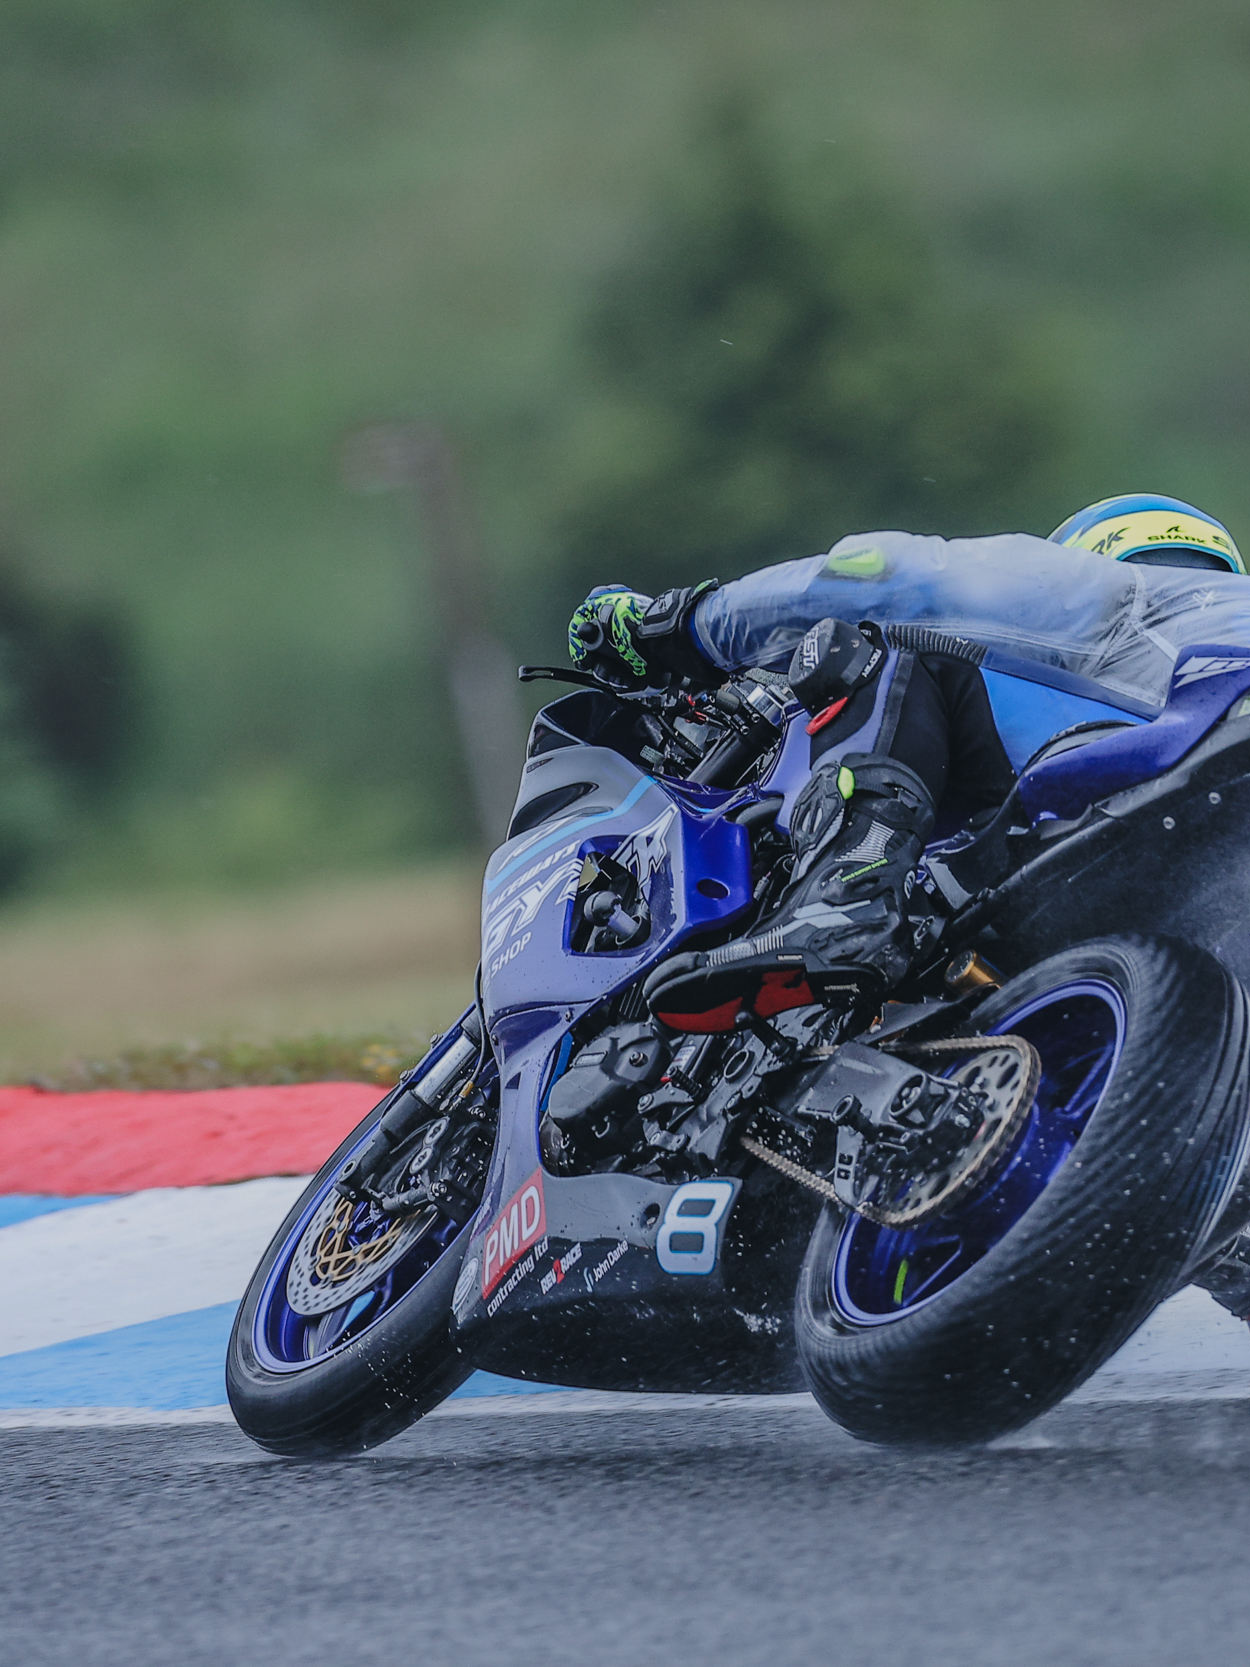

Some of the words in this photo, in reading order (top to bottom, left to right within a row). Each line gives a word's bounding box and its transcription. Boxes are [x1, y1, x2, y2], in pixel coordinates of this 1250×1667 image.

[1147, 533, 1207, 545] SHARK
[490, 931, 532, 979] SHOP
[484, 1184, 542, 1287] PMD
[656, 1180, 734, 1276] 8
[486, 1254, 536, 1318] contracting
[535, 1235, 550, 1262] ltd
[592, 1257, 610, 1283] John
[606, 1239, 629, 1270] Darke
